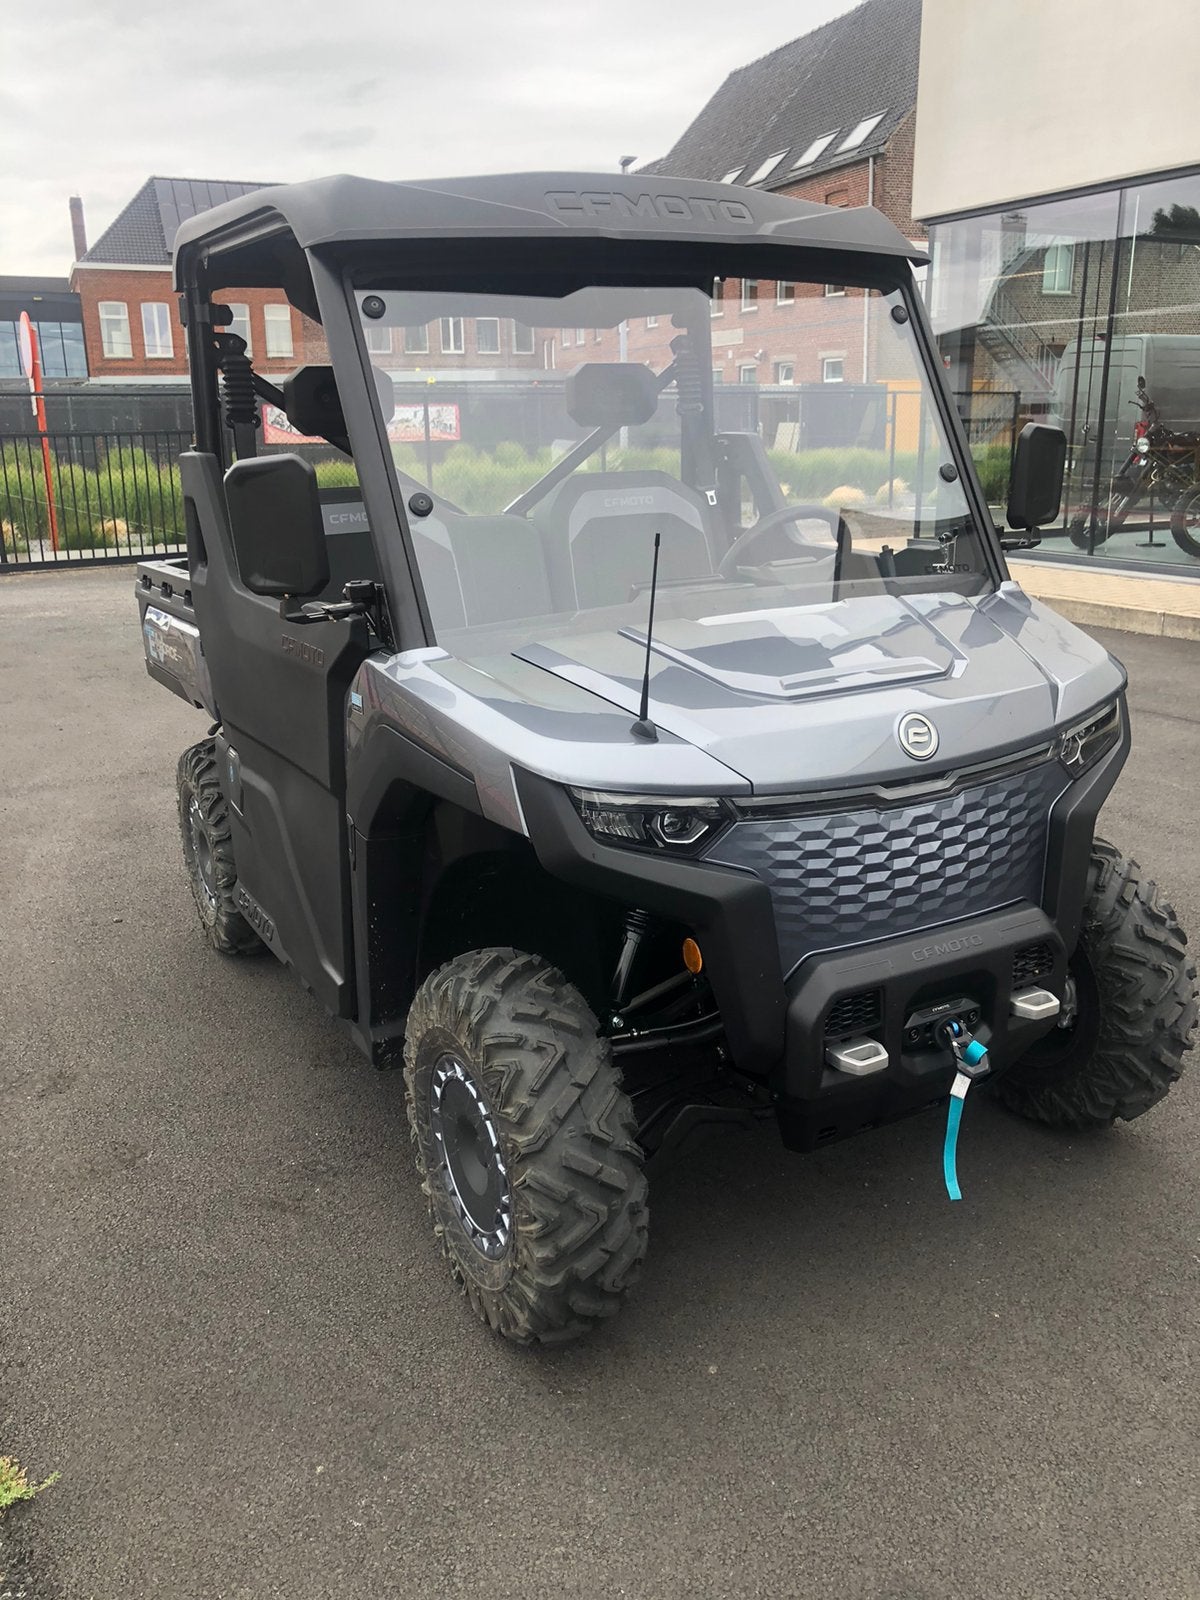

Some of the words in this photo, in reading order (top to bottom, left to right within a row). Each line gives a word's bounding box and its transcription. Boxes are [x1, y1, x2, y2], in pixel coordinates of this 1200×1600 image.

[543, 190, 755, 224] CFMOTO
[603, 495, 654, 508] CFMOTO
[281, 633, 326, 668] CFMOTO
[238, 888, 275, 942] CFMOTO
[911, 934, 984, 961] CFMOTO
